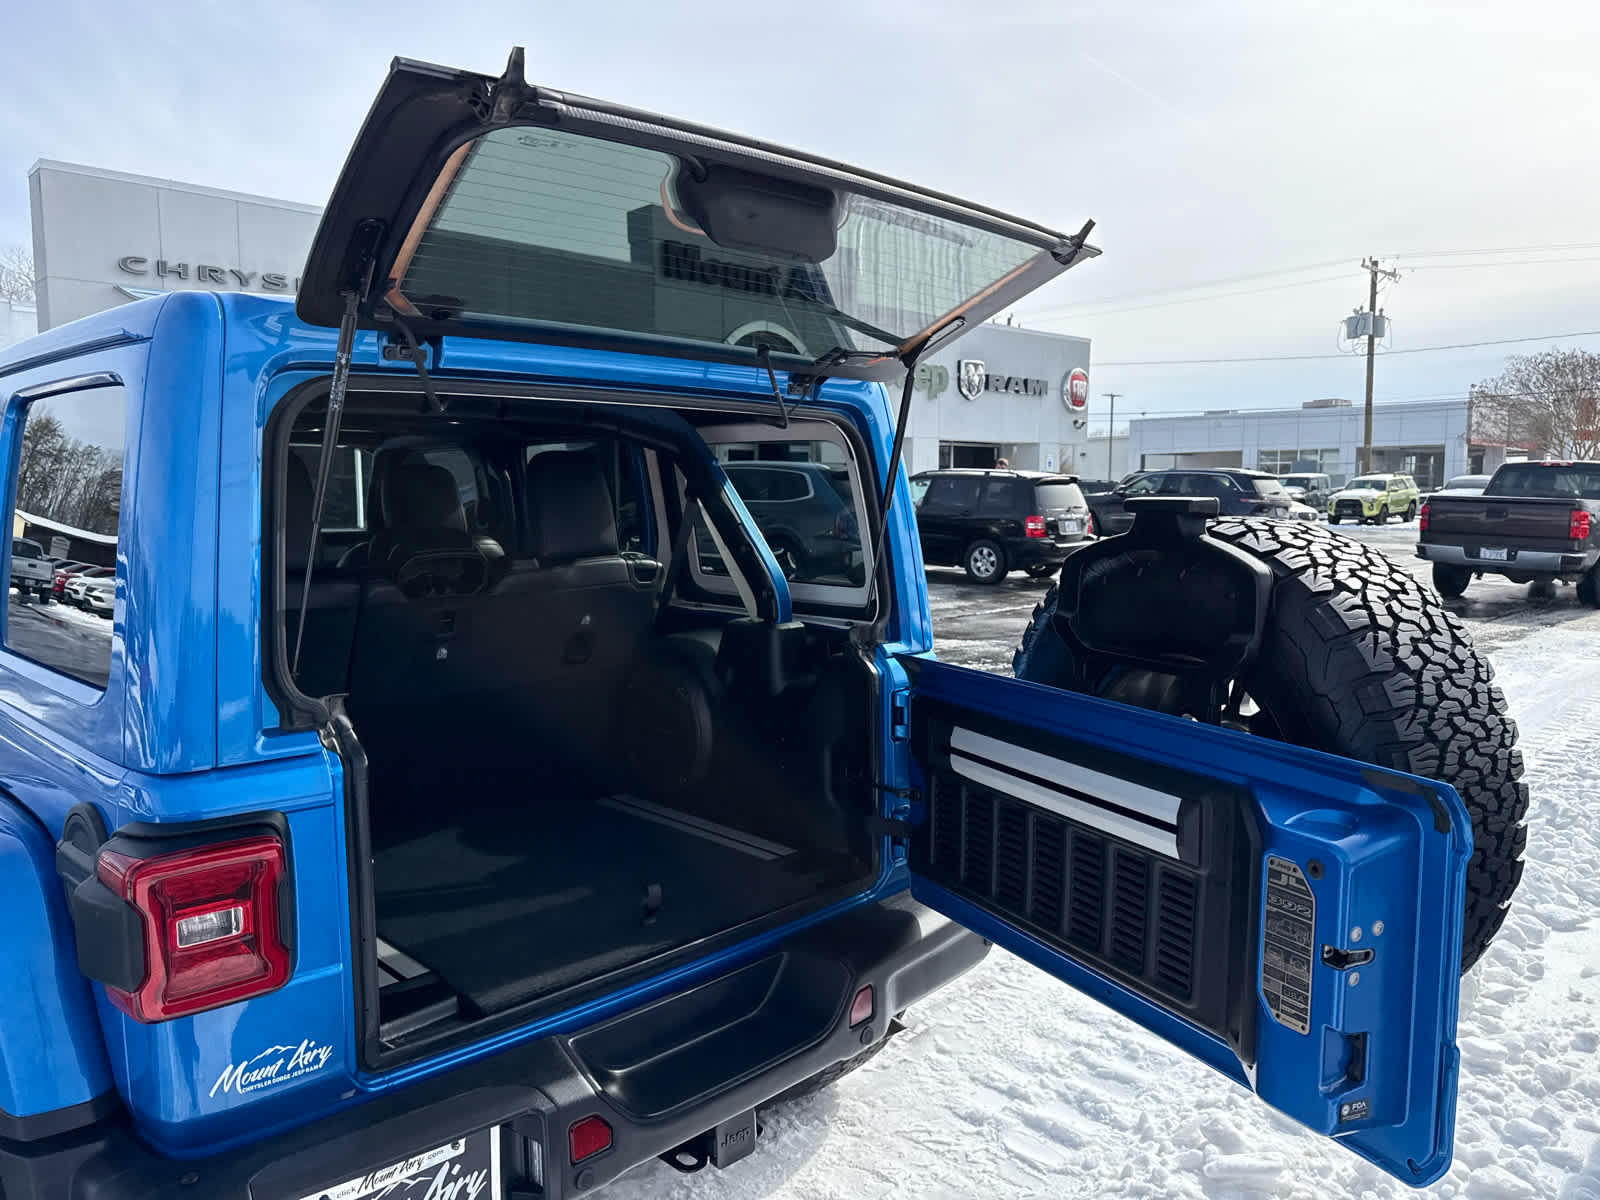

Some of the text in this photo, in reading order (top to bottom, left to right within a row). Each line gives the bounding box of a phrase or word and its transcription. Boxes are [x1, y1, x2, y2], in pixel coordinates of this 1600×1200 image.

[984, 374, 1049, 397] RAM
[209, 1039, 333, 1099] Mount Airy
[241, 1079, 272, 1094] CHRYSLER
[271, 1073, 291, 1084] DODGE
[291, 1068, 305, 1078] JEEP
[721, 1127, 751, 1147] Jeep
[336, 1186, 357, 1199] click
[356, 1170, 397, 1194] Mount
[399, 1158, 425, 1174] Airy
[423, 1161, 488, 1200] Airy
